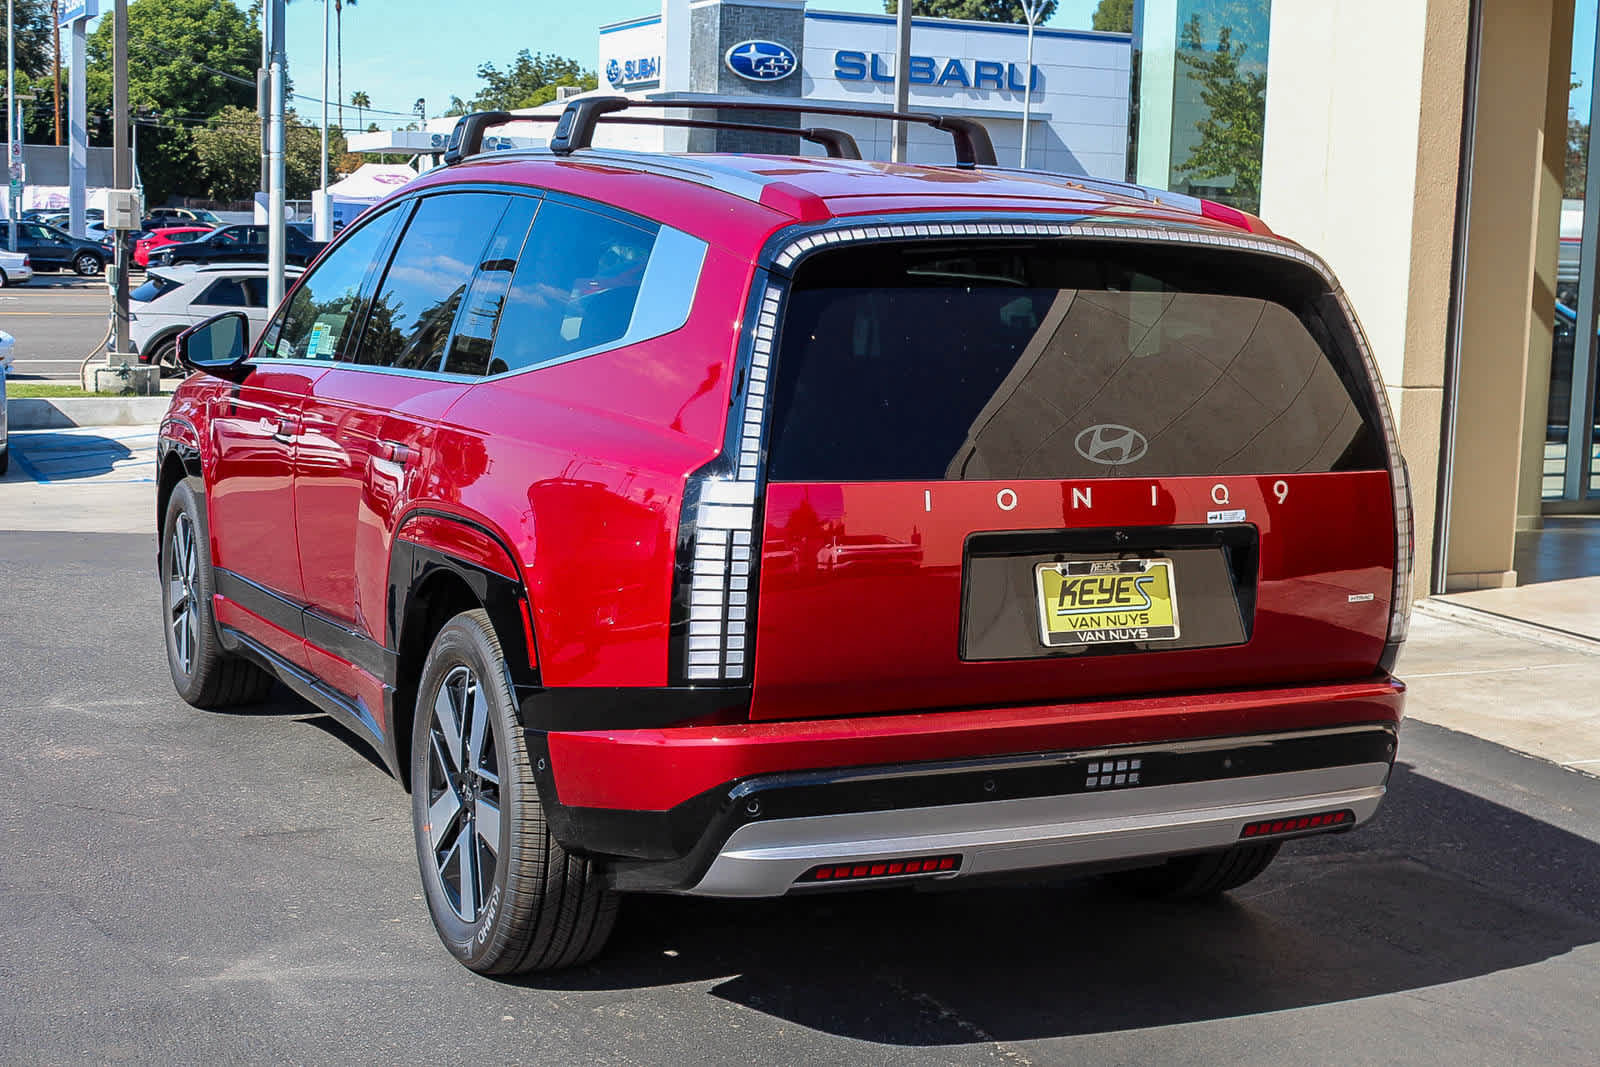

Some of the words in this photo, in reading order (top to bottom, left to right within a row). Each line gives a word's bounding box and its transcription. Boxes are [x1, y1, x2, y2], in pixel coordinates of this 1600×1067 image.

[834, 50, 1038, 91] SUBARU
[1273, 480, 1289, 504] 9
[1058, 576, 1154, 609] KEYES
[1068, 615, 1101, 628] VAN
[1106, 613, 1149, 626] NUYS
[1077, 630, 1106, 642] VAN
[1109, 628, 1148, 641] NUYS
[478, 884, 500, 944] KUMHO
